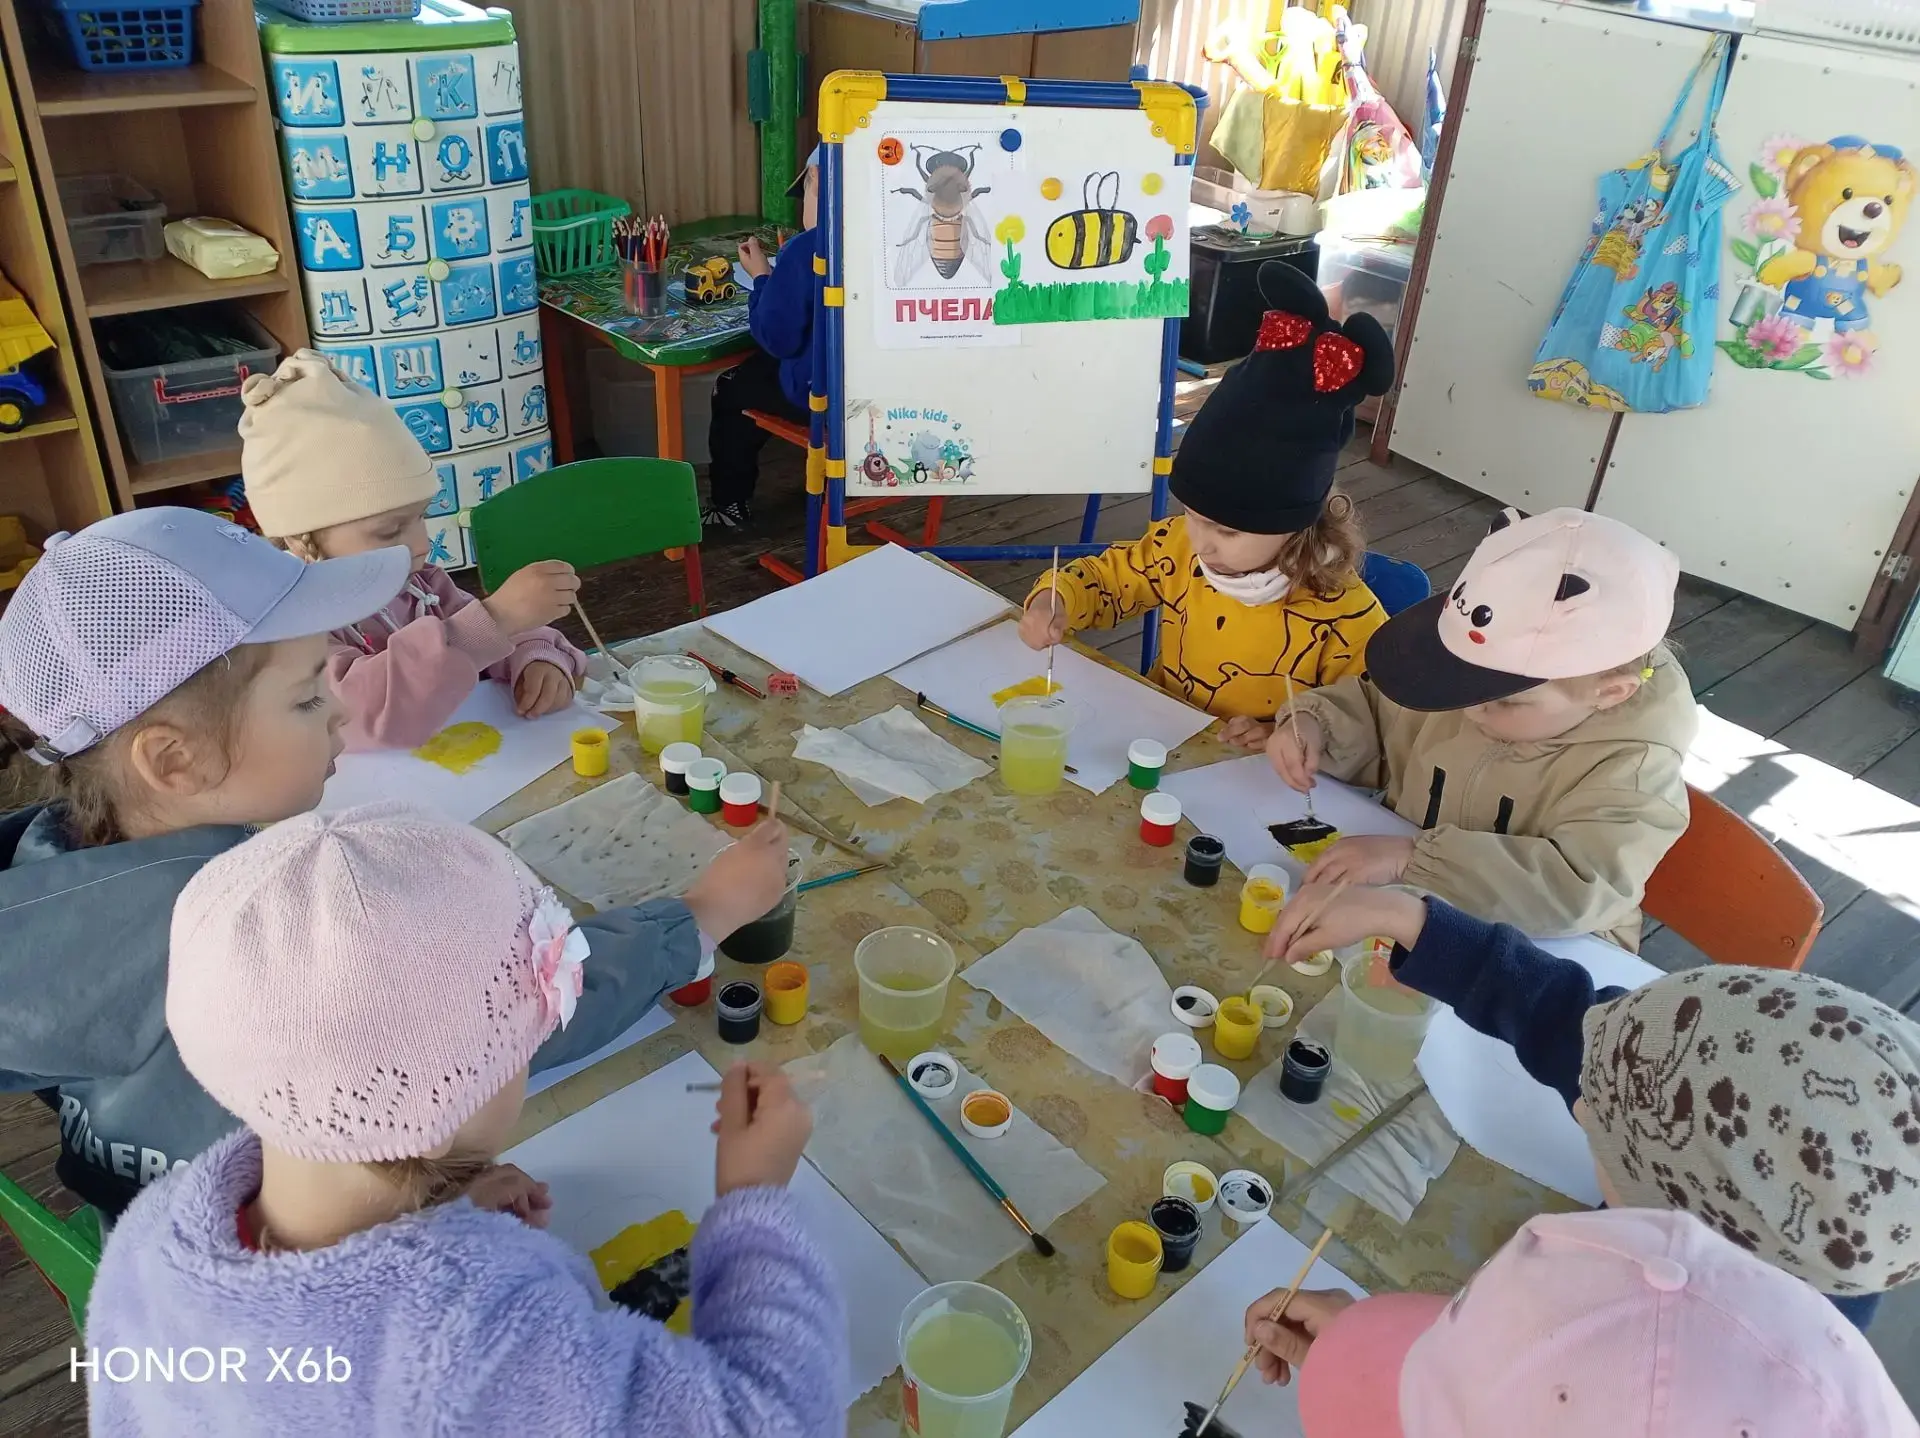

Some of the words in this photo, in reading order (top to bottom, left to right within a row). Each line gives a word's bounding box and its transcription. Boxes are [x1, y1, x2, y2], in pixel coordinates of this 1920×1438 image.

[437, 72, 467, 110] К
[375, 141, 408, 182] Н
[438, 134, 471, 173] О
[313, 217, 352, 264] А
[388, 214, 416, 252] Б
[447, 207, 478, 243] В
[466, 401, 499, 429] Ю
[523, 384, 547, 424] Я
[472, 465, 503, 501] Т
